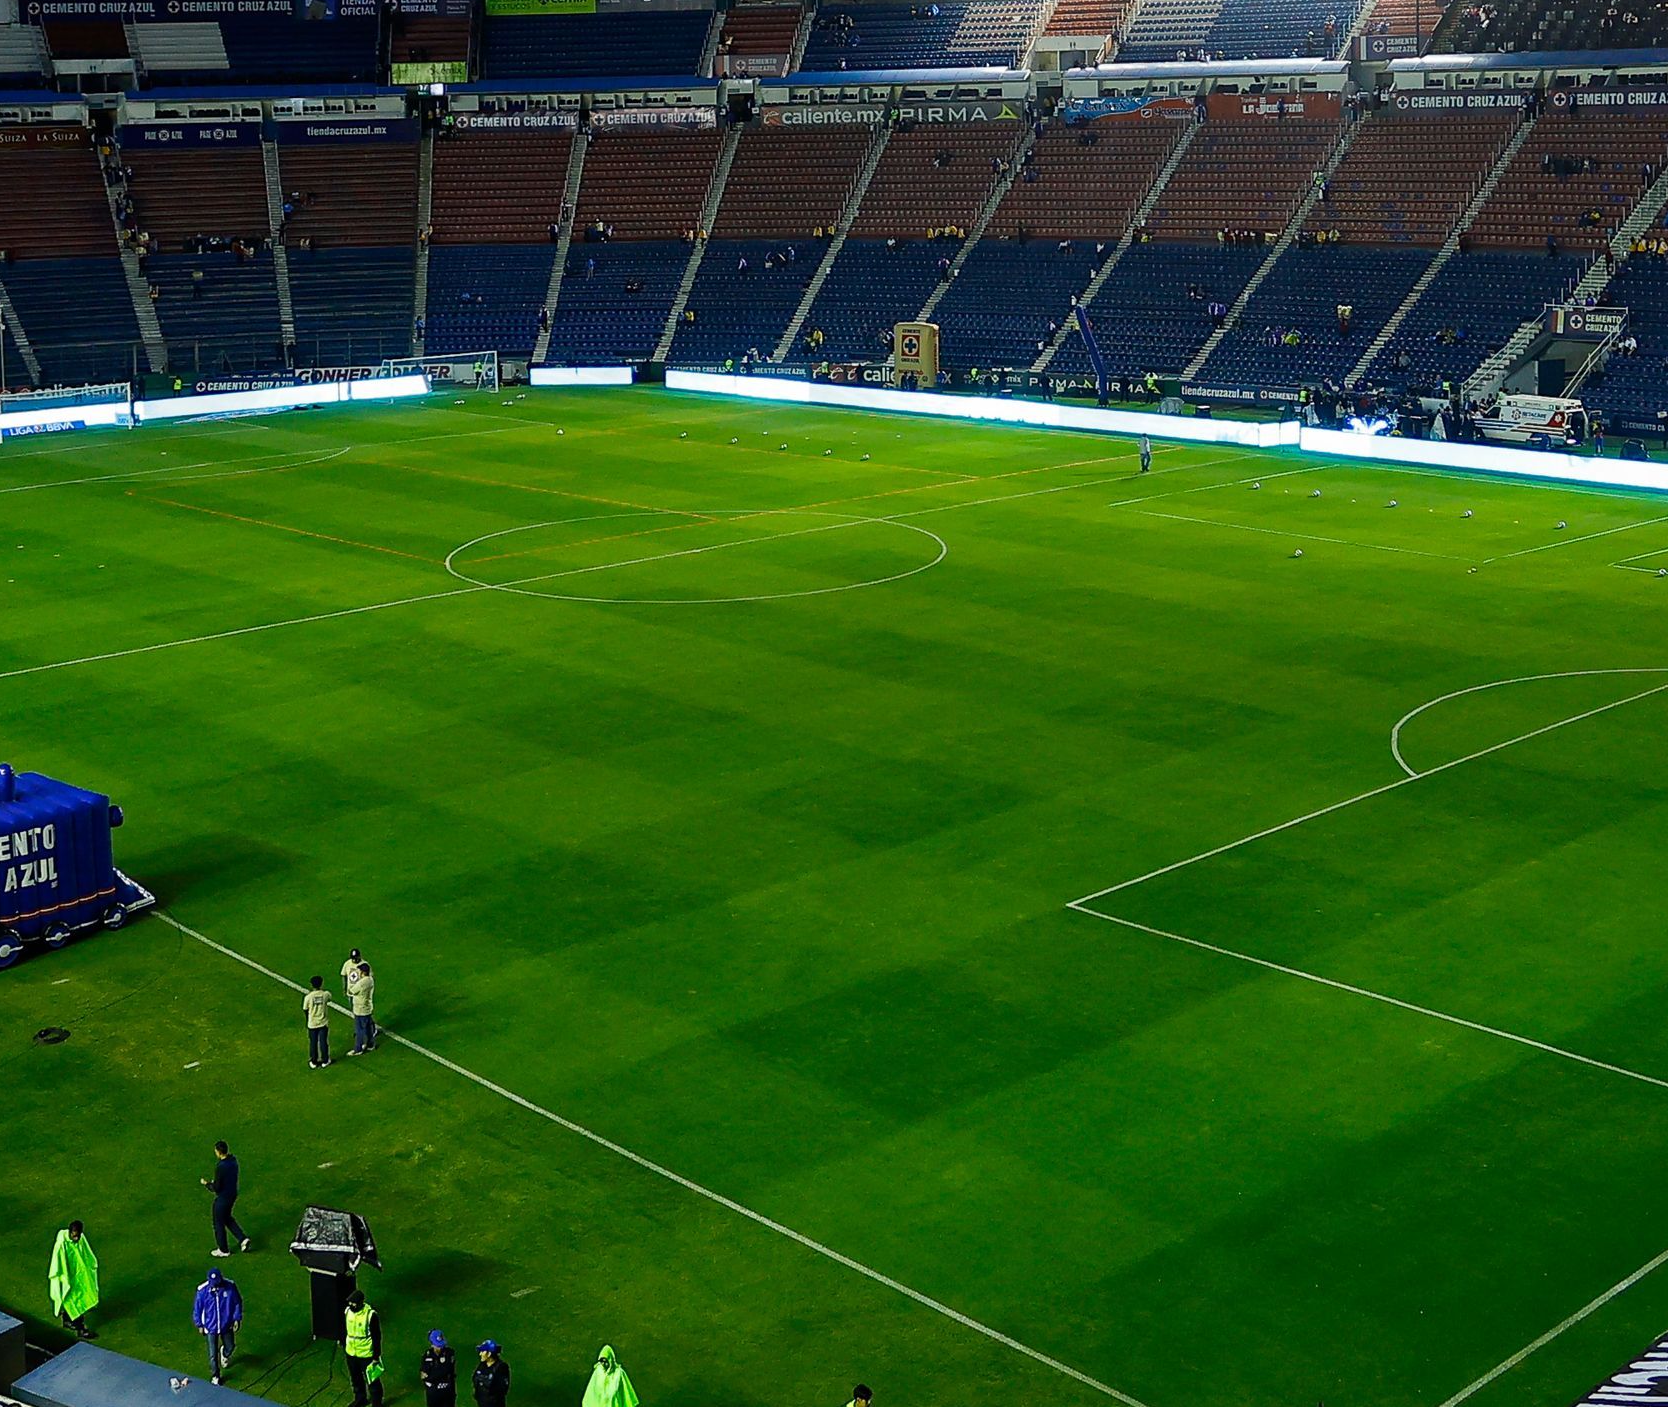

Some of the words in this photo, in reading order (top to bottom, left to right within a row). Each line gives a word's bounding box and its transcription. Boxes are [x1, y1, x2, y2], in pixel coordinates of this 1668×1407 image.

[43, 2, 96, 13] CEMENTO
[99, 2, 128, 13] CRUZ
[129, 2, 156, 13] AZUL
[182, 1, 235, 12] CEMENTO
[238, 1, 265, 12] CRUZ
[266, 1, 293, 12] AZUL
[340, 6, 377, 16] OFICIAL
[401, 5, 419, 13] CRUZ
[420, 5, 438, 13] AZUL
[1411, 96, 1464, 109] CEMENTO
[1467, 96, 1494, 108] CRUZ
[1496, 95, 1524, 107] AZUL
[1628, 92, 1658, 104] CRUZ
[607, 113, 657, 125] CEMENTO
[660, 113, 687, 124] CRUZ
[687, 112, 715, 123] AZUL
[783, 108, 885, 125] caliente.mx
[900, 106, 989, 123] PIRMA
[470, 116, 521, 127] CEMENTO
[523, 116, 550, 127] CRUZ
[551, 115, 577, 126] AZUL
[36, 133, 49, 142] LA
[52, 131, 81, 142] SUIZA
[307, 125, 388, 137] tiendacruzazul.mx
[0, 133, 29, 143] SUIZA
[1586, 314, 1623, 323] CEMENTO
[1585, 324, 1603, 332] CRUZ
[208, 381, 249, 392] CEMENTO
[1181, 385, 1255, 400] tiendacruzazul.mx
[1269, 391, 1299, 401] CEMENTO
[10, 424, 33, 437] LIGA
[46, 421, 75, 433] BBVA
[3, 856, 58, 894] AZUL
